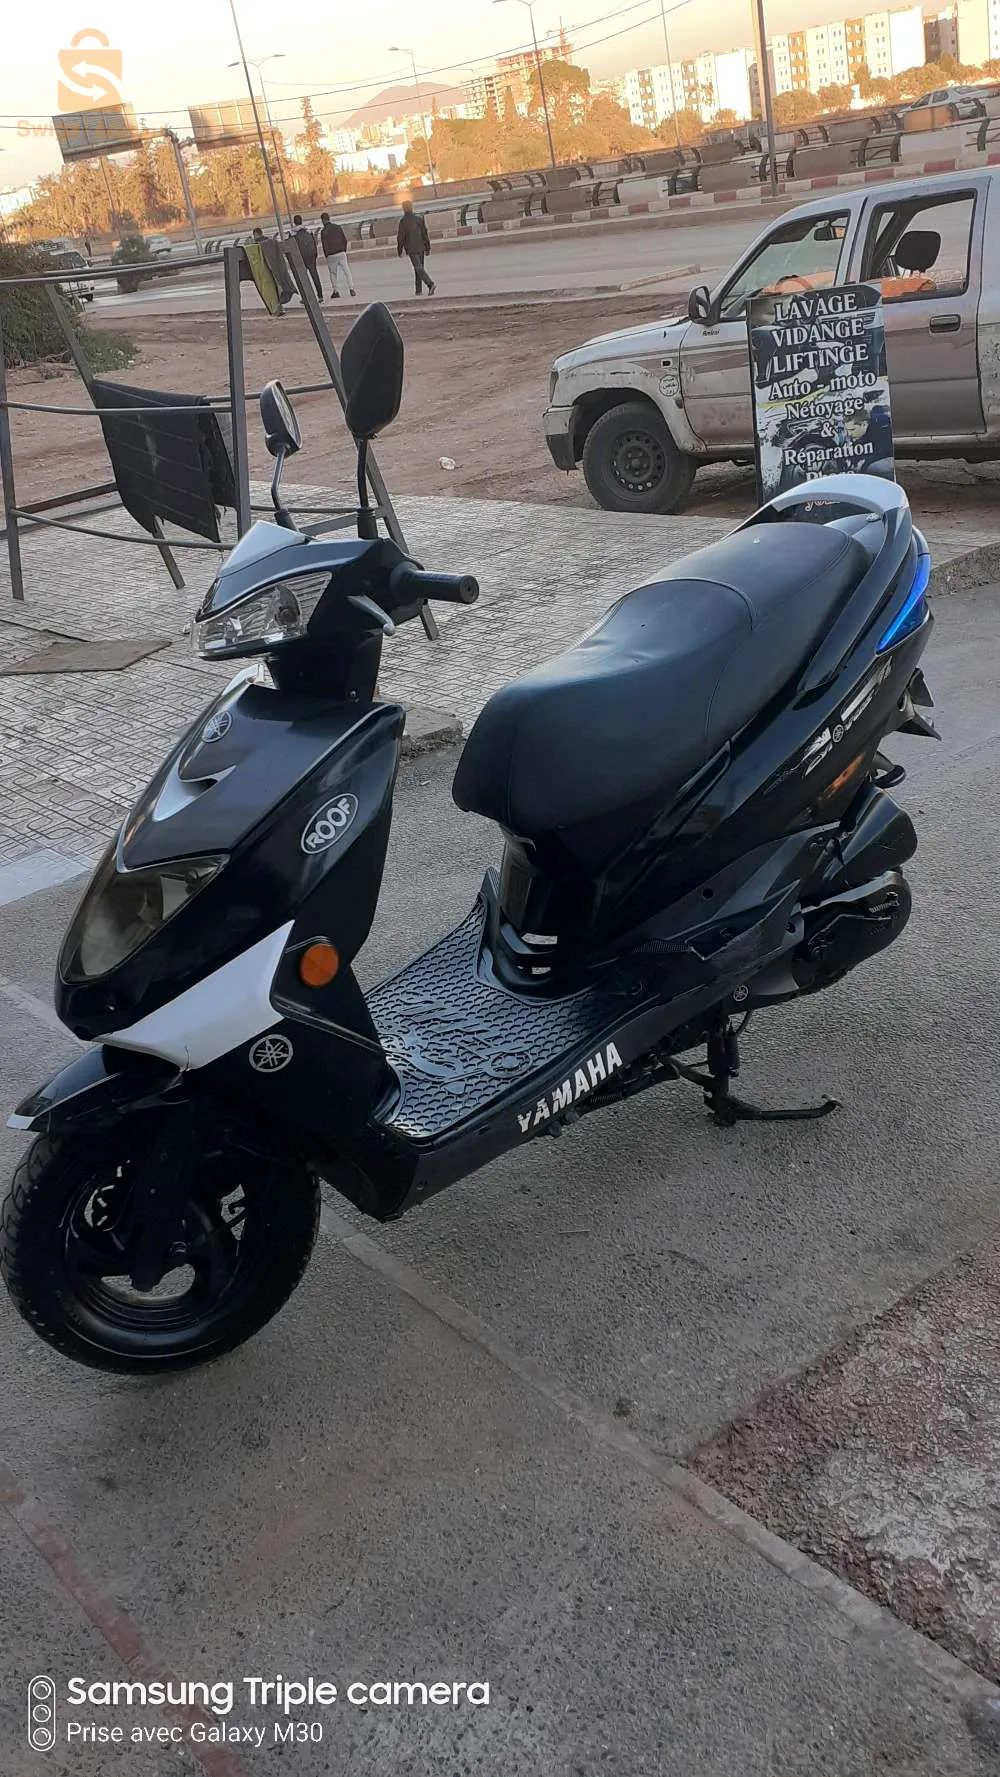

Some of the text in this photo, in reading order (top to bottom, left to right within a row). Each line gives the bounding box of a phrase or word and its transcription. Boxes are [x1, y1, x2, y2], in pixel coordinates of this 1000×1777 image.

[774, 292, 858, 322] LAVAGE
[771, 318, 866, 347] VIDANGE
[773, 343, 869, 374] LIFTINGE
[768, 380, 812, 401] Auto
[830, 370, 877, 391] moto
[785, 396, 865, 421] Nétoyage
[820, 422, 835, 439] &
[784, 441, 874, 467] Réparation
[305, 797, 351, 849] ROOF
[517, 1041, 623, 1133] YAMAHA
